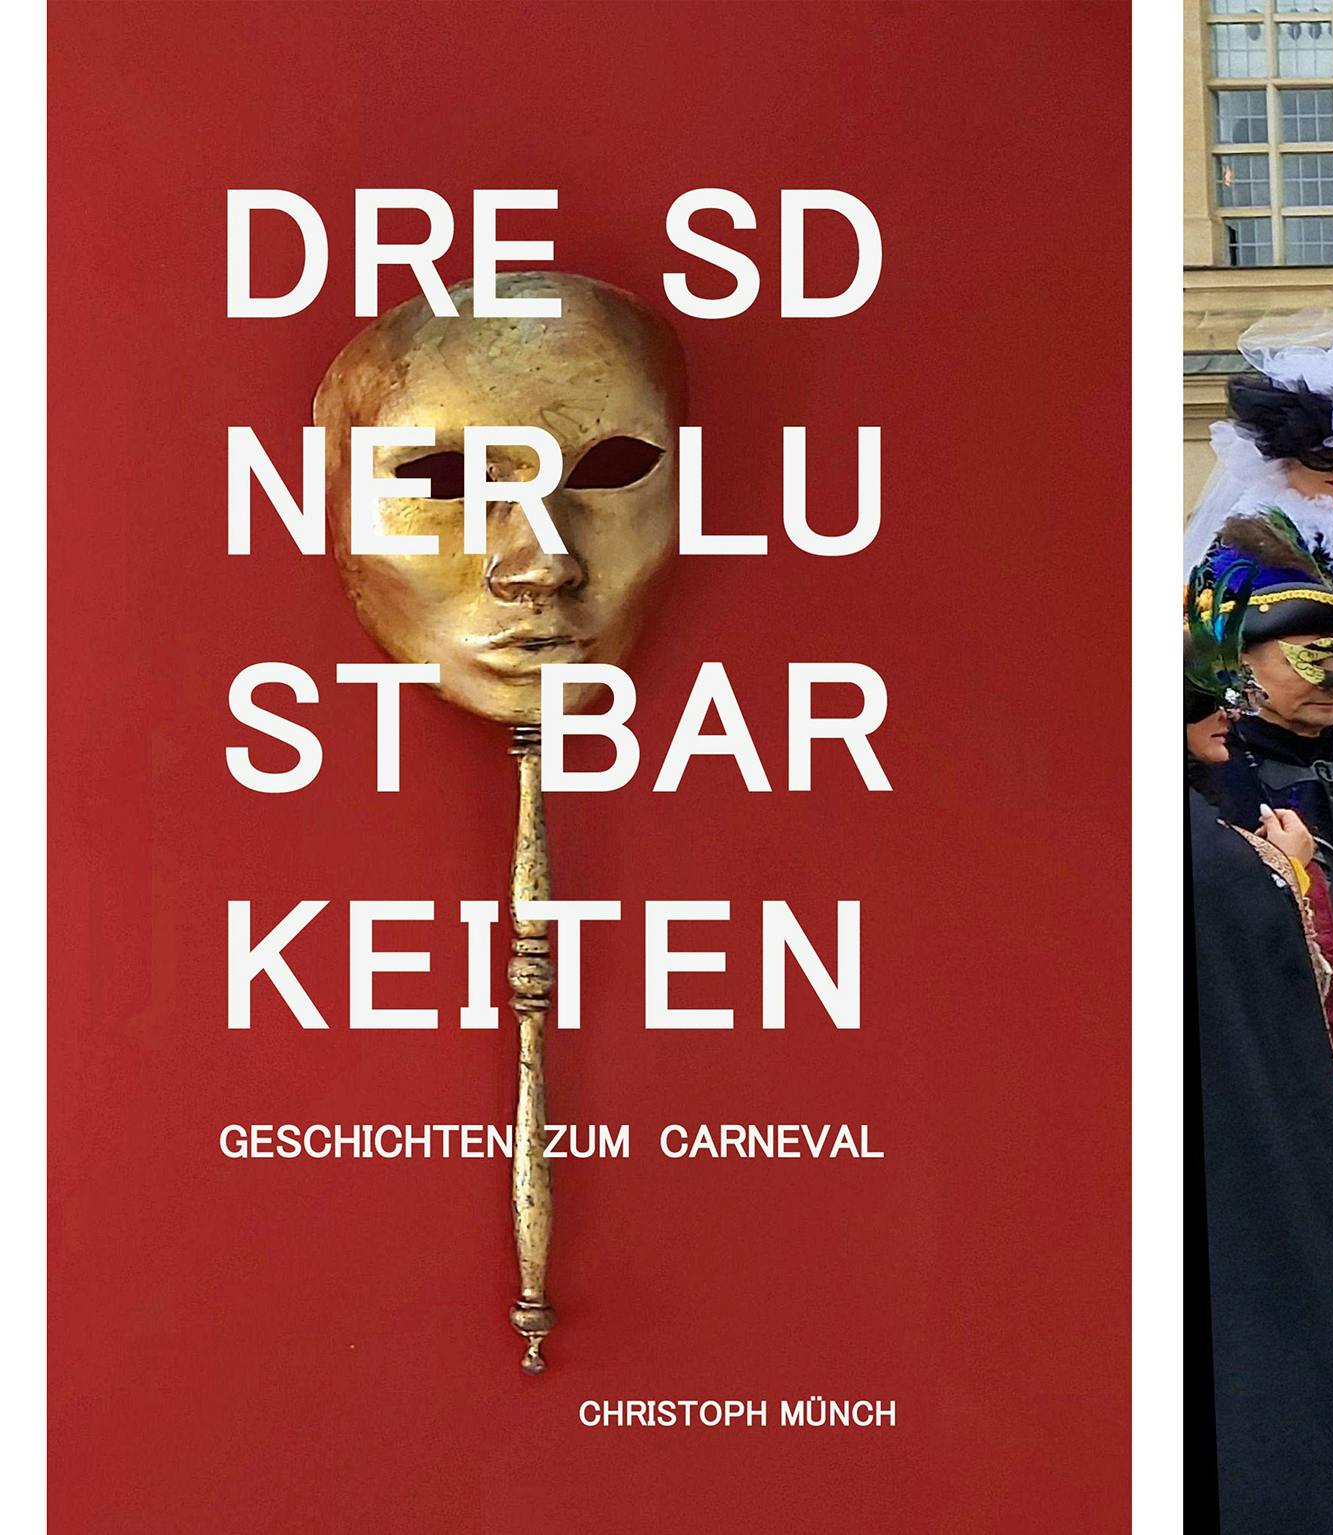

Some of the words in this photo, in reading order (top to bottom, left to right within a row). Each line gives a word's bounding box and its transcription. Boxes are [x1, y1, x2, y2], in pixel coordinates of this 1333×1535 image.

[228, 188, 562, 318] DRE
[662, 187, 883, 320] SD
[228, 426, 569, 555] NER
[679, 426, 881, 557] LU
[226, 661, 441, 794] ST
[540, 661, 894, 792] BAR
[228, 900, 861, 1029] KEITEN
[219, 1124, 513, 1159] GESCHICHTEN
[542, 1124, 631, 1159] ZUM
[660, 1124, 885, 1159] CARNEVAL
[579, 1400, 767, 1427] CHRISTOPH
[781, 1395, 897, 1427] MÜNCH
